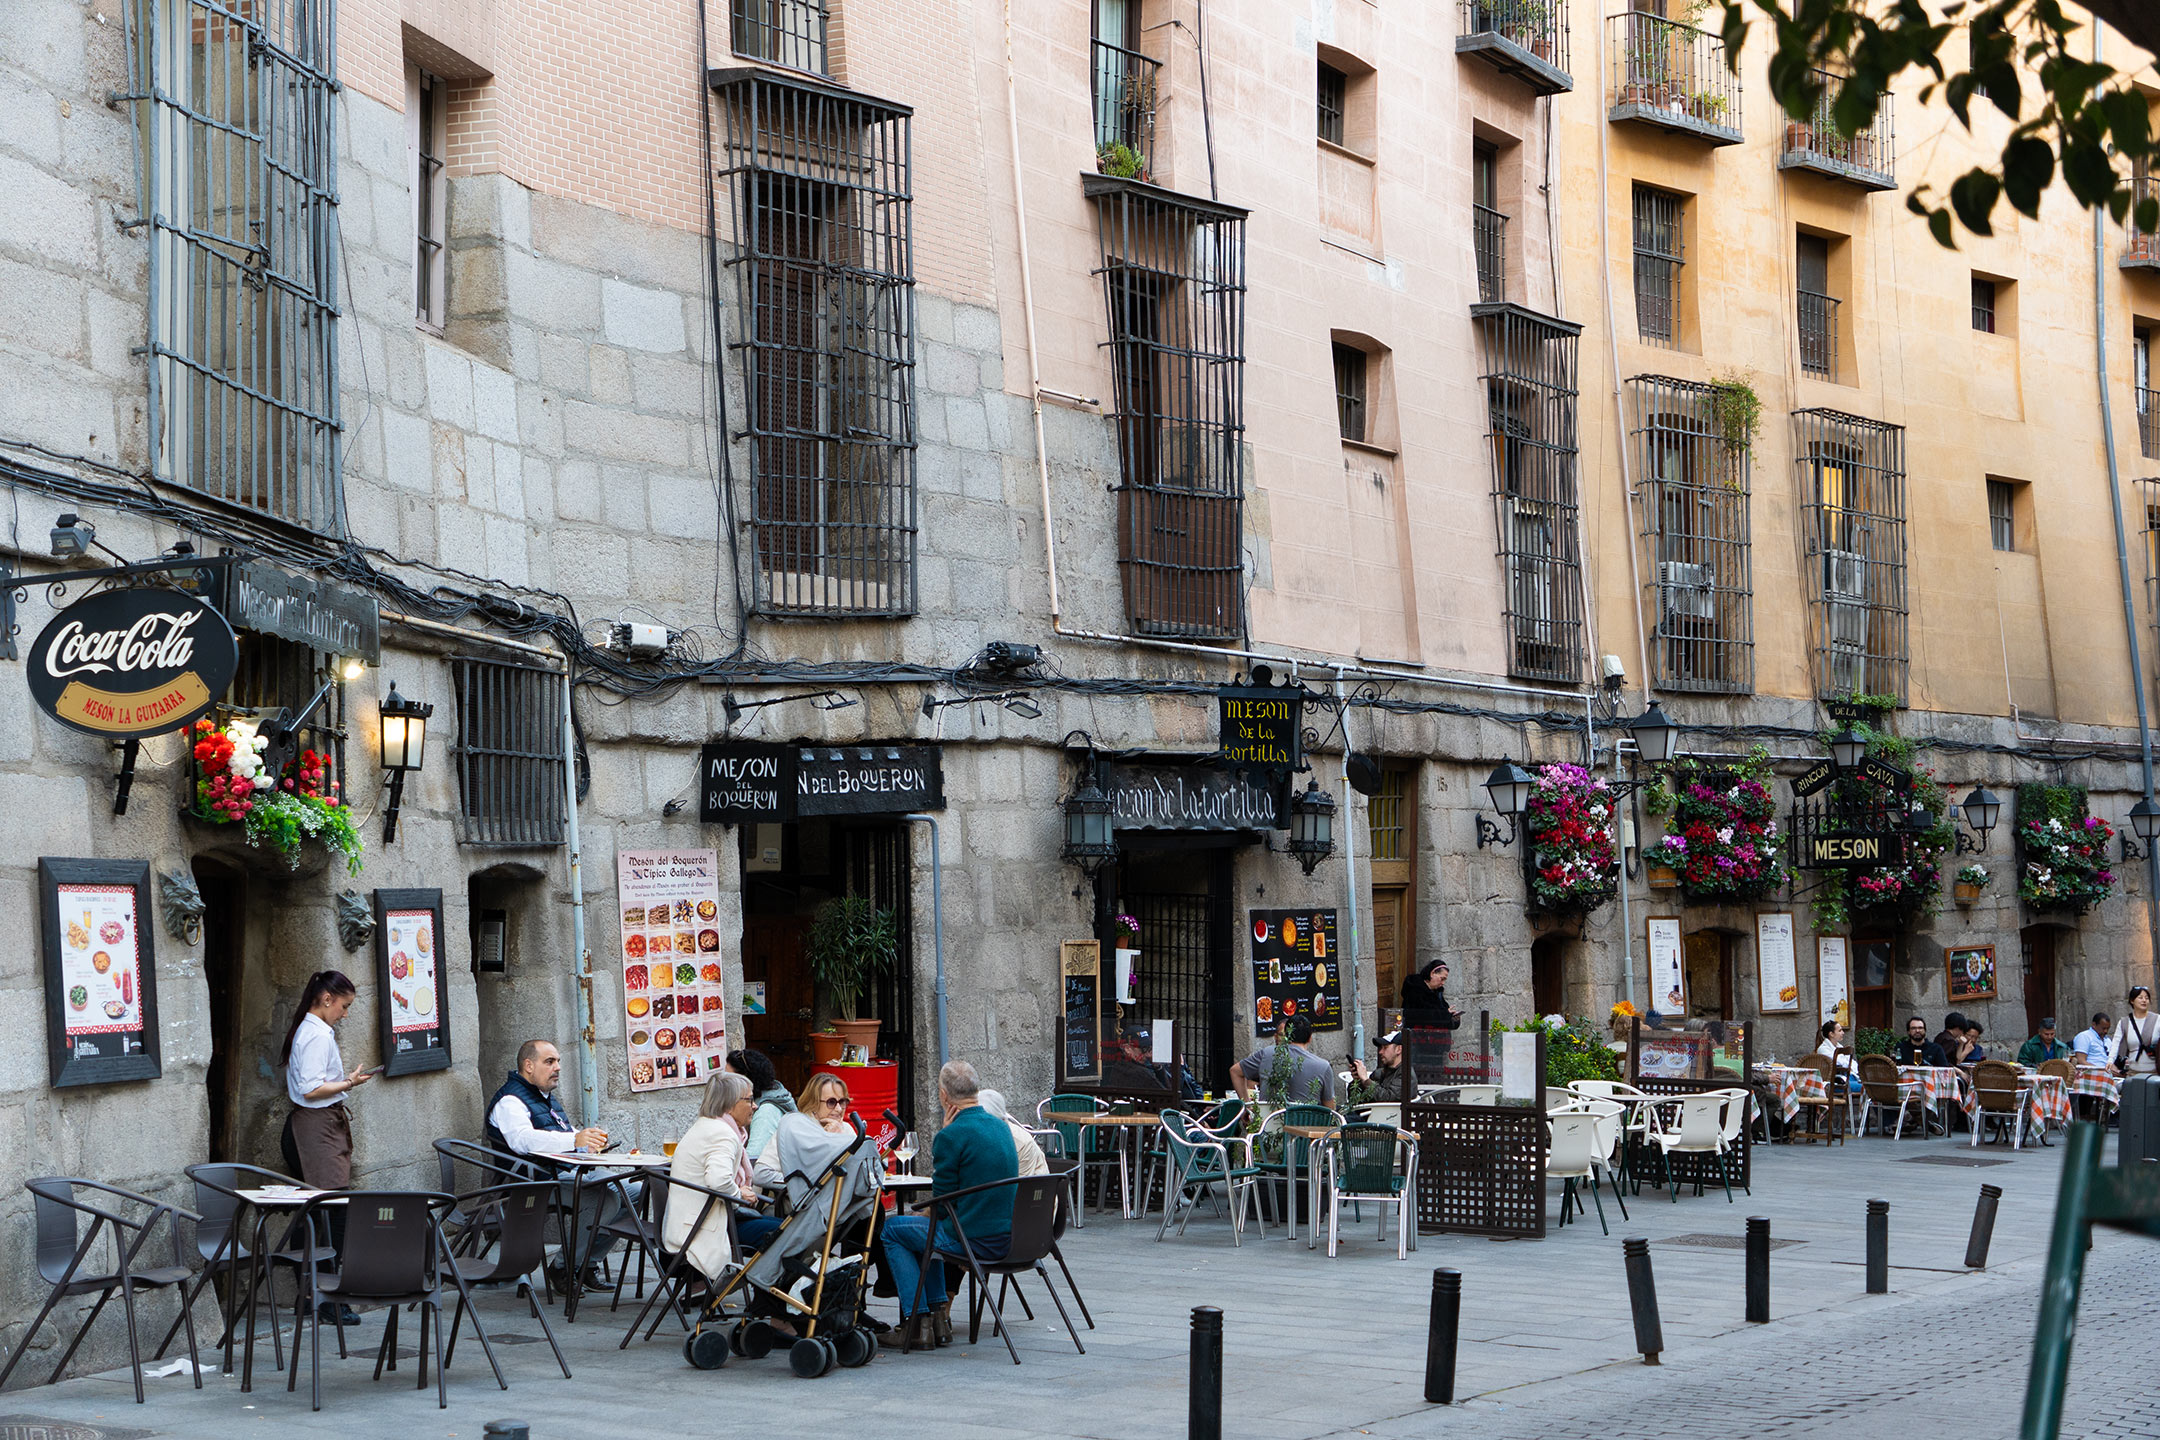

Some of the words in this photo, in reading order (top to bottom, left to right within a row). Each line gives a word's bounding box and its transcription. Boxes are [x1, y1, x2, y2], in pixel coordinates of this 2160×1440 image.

[46, 609, 203, 678] Coca-Cola
[82, 697, 115, 722] MESÓN
[118, 707, 131, 724] LA
[136, 689, 186, 722] GUITARRA
[1834, 707, 1845, 716] DE
[1846, 708, 1857, 717] LA
[1258, 722, 1276, 740] la
[1224, 743, 1289, 763] tortilla
[1866, 763, 1895, 786] CAVA
[812, 777, 837, 794] DEL
[1178, 776, 1201, 820] la
[1201, 782, 1276, 820] tortilla
[1815, 838, 1879, 861] MESON
[629, 855, 655, 867] Mesón
[657, 855, 669, 866] del
[672, 855, 708, 867] Boquerón
[643, 868, 667, 880] Típico
[669, 867, 697, 879] Gallego
